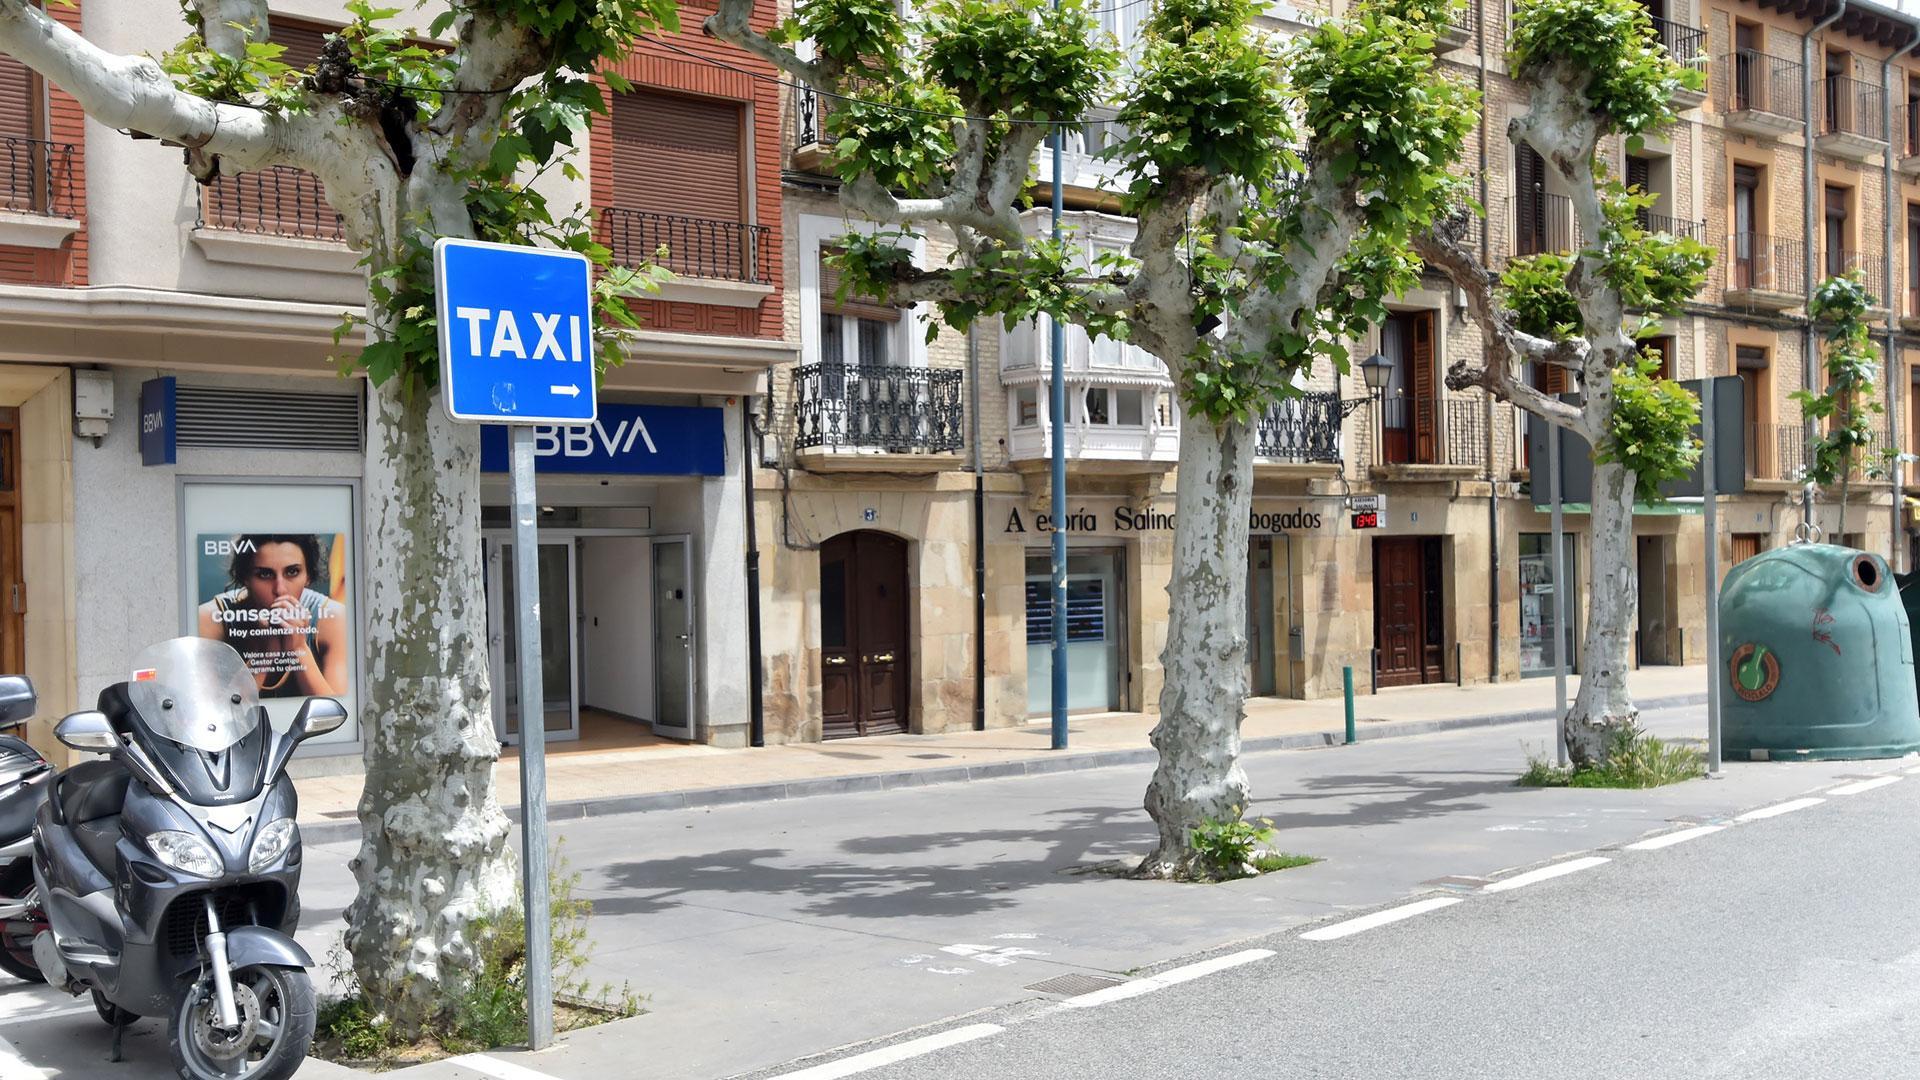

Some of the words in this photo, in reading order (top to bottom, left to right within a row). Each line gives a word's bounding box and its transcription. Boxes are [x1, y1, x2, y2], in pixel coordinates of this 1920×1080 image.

[456, 306, 582, 362] TAXI
[144, 410, 163, 433] BBVA
[533, 416, 658, 458] BBVA
[1249, 506, 1321, 533] bogados
[204, 539, 257, 555] BBVA
[212, 605, 312, 624] conseguir.
[318, 604, 335, 619] ir.
[229, 628, 247, 638] Hoy
[250, 627, 293, 637] comienza
[297, 626, 319, 635] todo.
[250, 658, 272, 666] Gestor
[274, 657, 300, 665] Contigo
